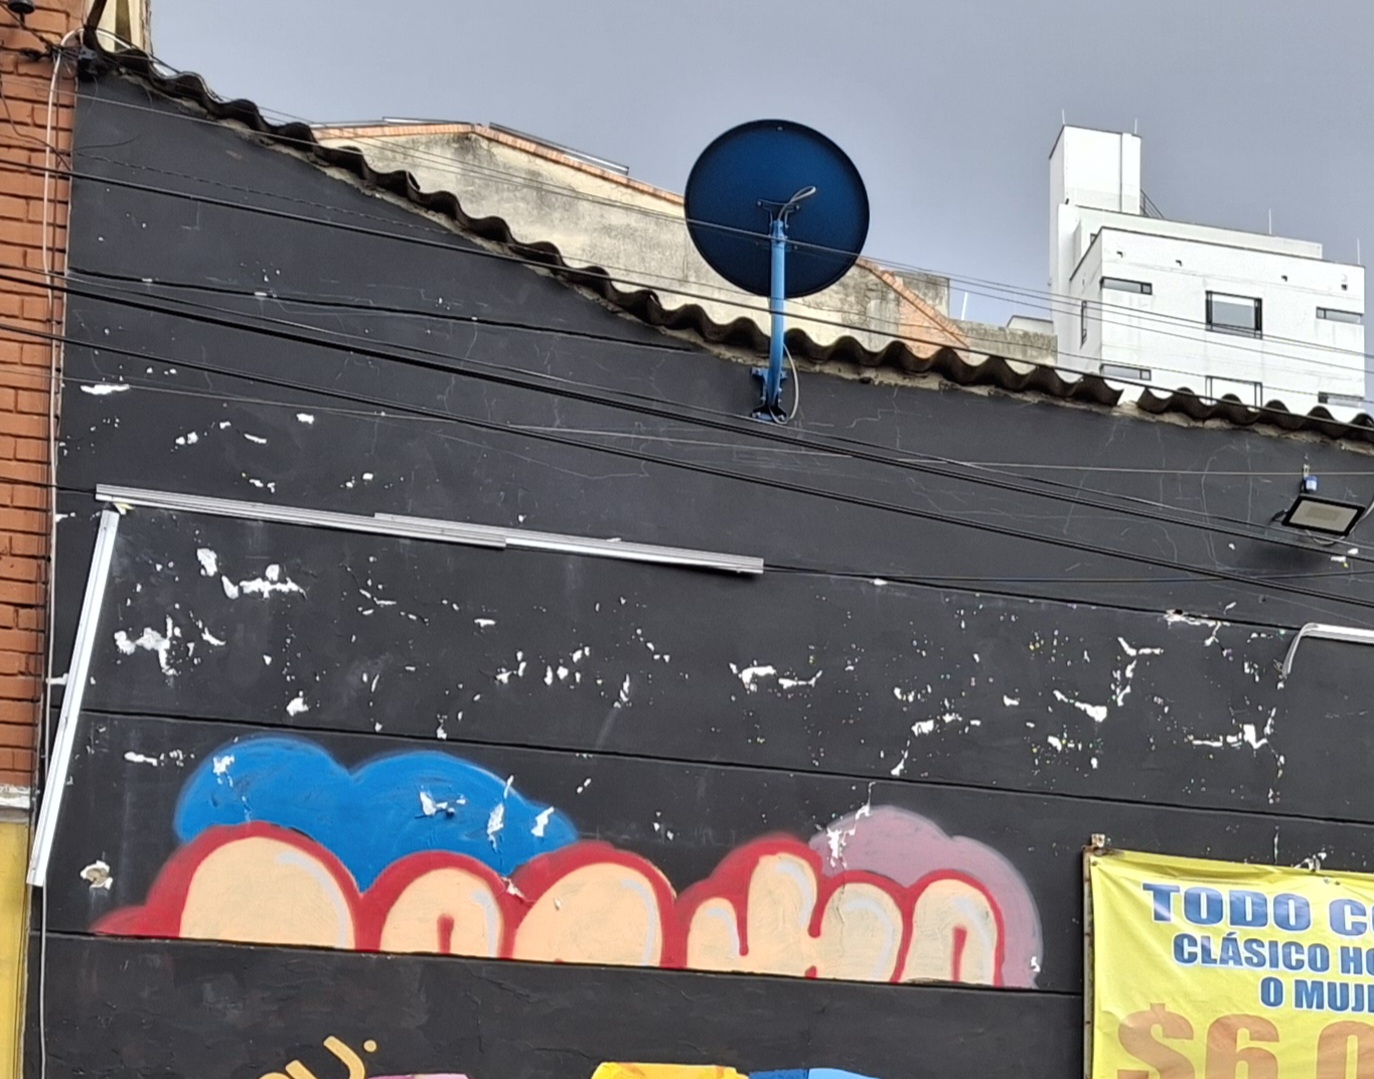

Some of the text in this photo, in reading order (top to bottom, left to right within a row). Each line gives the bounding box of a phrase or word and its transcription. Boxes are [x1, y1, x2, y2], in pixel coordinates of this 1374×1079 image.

[1142, 882, 1312, 931] TODO
[1173, 931, 1330, 973] CLÁSICO
[1260, 976, 1284, 1007] O
